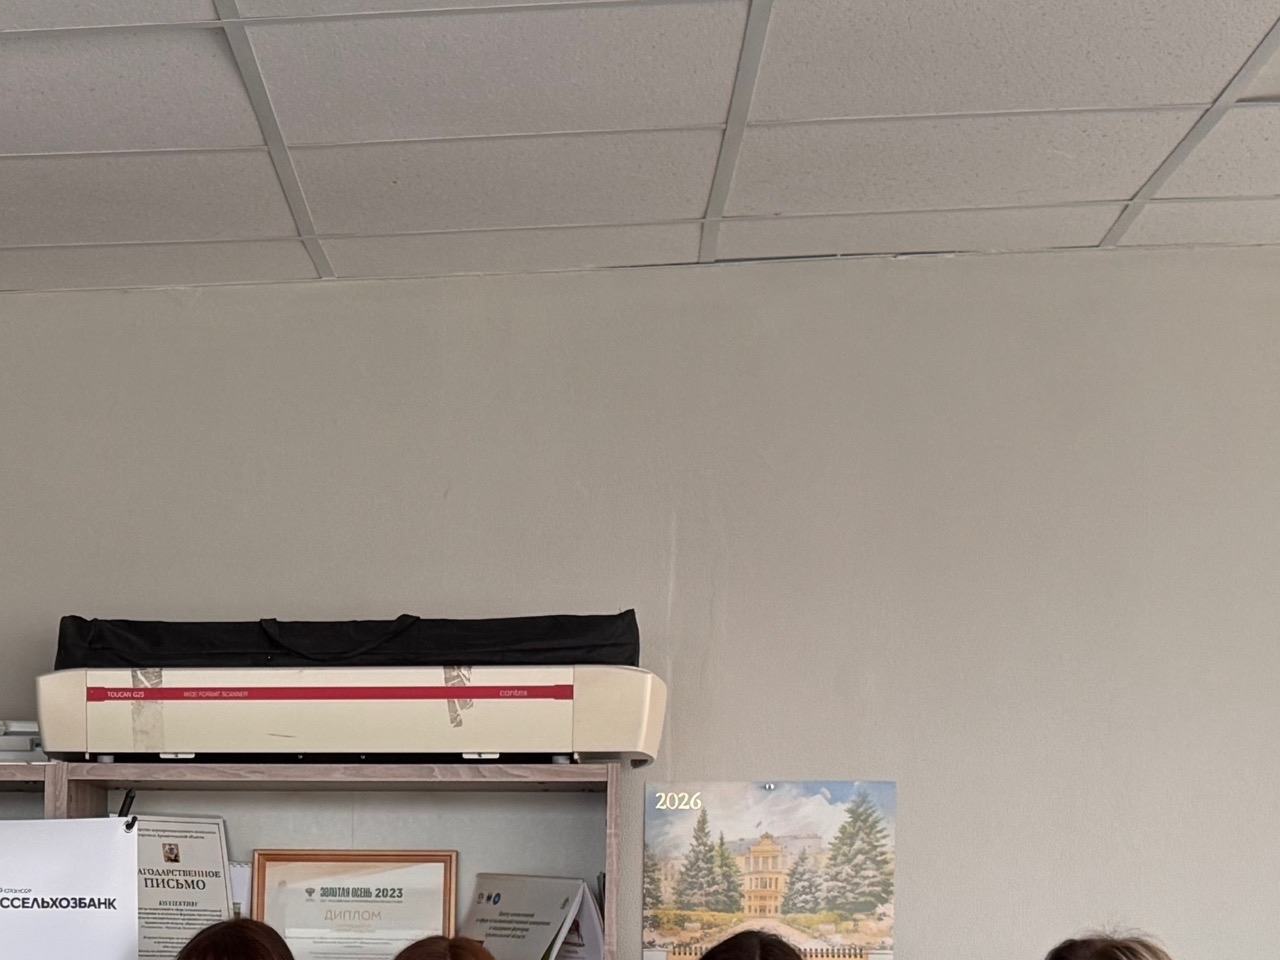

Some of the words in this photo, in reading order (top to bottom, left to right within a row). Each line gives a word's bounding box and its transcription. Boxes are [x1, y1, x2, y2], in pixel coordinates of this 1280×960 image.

[655, 792, 702, 811] 2026
[138, 868, 222, 878] АГОДАРСТВЕННОЕ
[144, 878, 206, 891] ПИСЬМО
[351, 887, 373, 898] ОСЕНЬ
[375, 888, 403, 898] 2023
[324, 910, 382, 921] ДИПЛОМ
